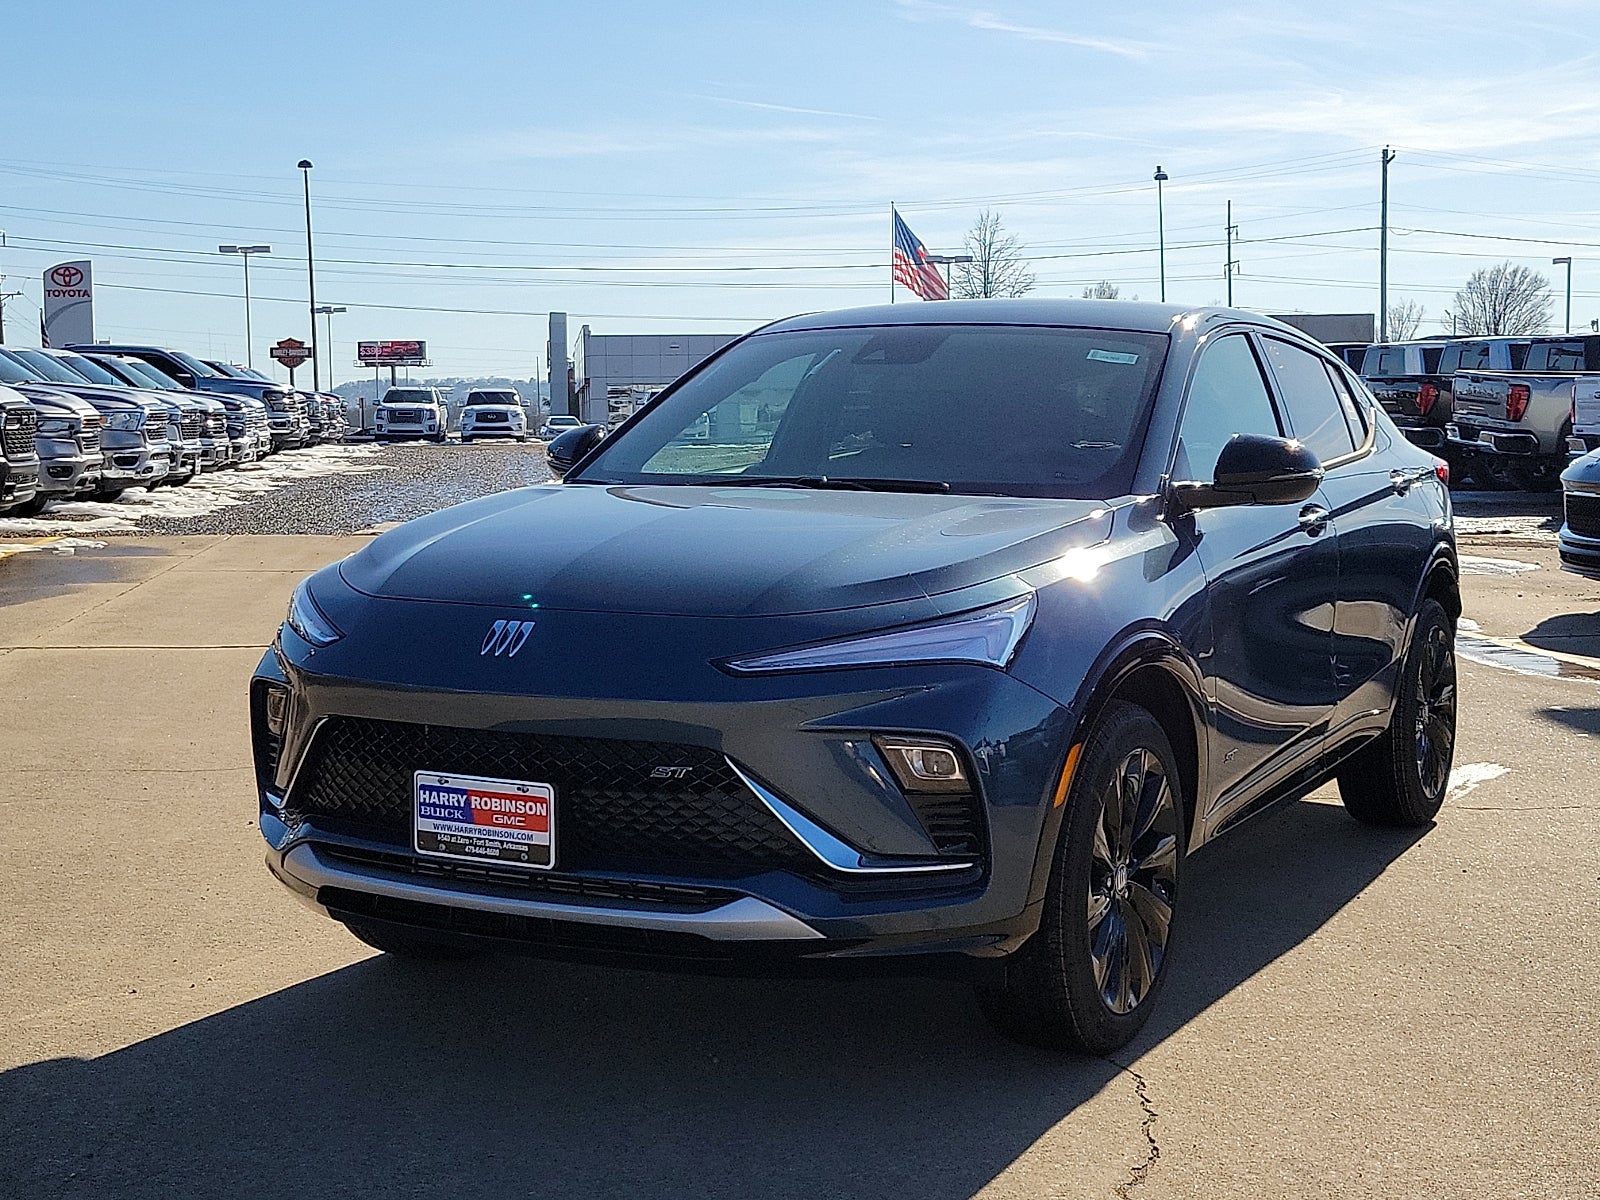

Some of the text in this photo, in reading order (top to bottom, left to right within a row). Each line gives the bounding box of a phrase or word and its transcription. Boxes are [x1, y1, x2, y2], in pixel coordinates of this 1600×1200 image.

[46, 289, 91, 298] TOYOTA
[650, 766, 693, 778] ST
[419, 789, 547, 816] HARRY ROBINSON
[420, 805, 464, 819] BUICK
[492, 815, 526, 826] GMC
[432, 822, 534, 842] WWW.HARRYROBINSON.COM
[457, 836, 470, 844] Zero
[473, 837, 485, 846] Fort
[503, 841, 529, 852] Arkansas
